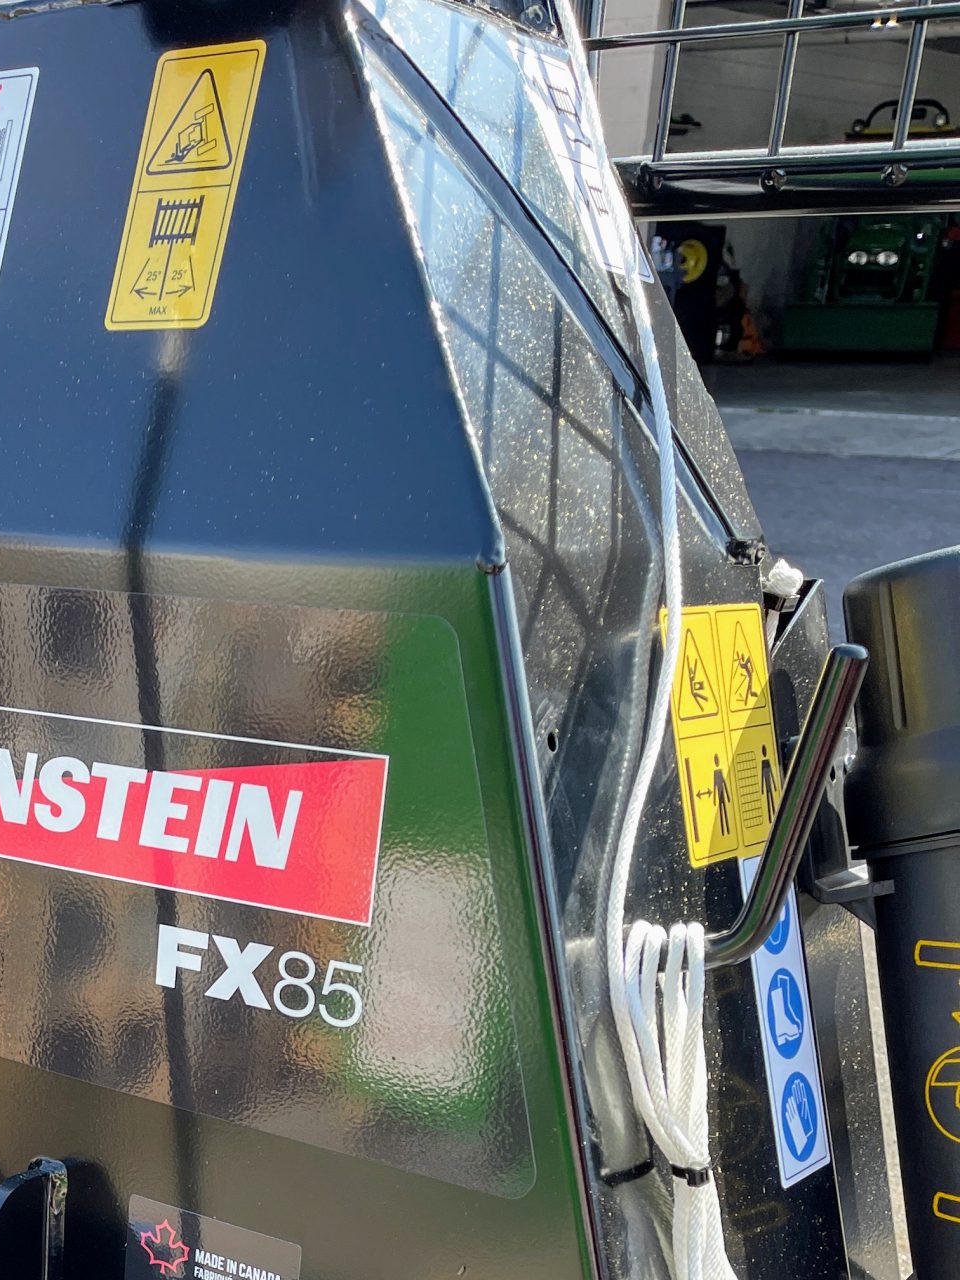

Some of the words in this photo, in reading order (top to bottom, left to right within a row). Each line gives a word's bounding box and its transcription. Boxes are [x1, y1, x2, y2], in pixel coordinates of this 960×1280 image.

[149, 306, 167, 315] MAX
[155, 923, 364, 1028] FX85
[194, 1248, 225, 1271] MADE
[226, 1258, 238, 1275] IN
